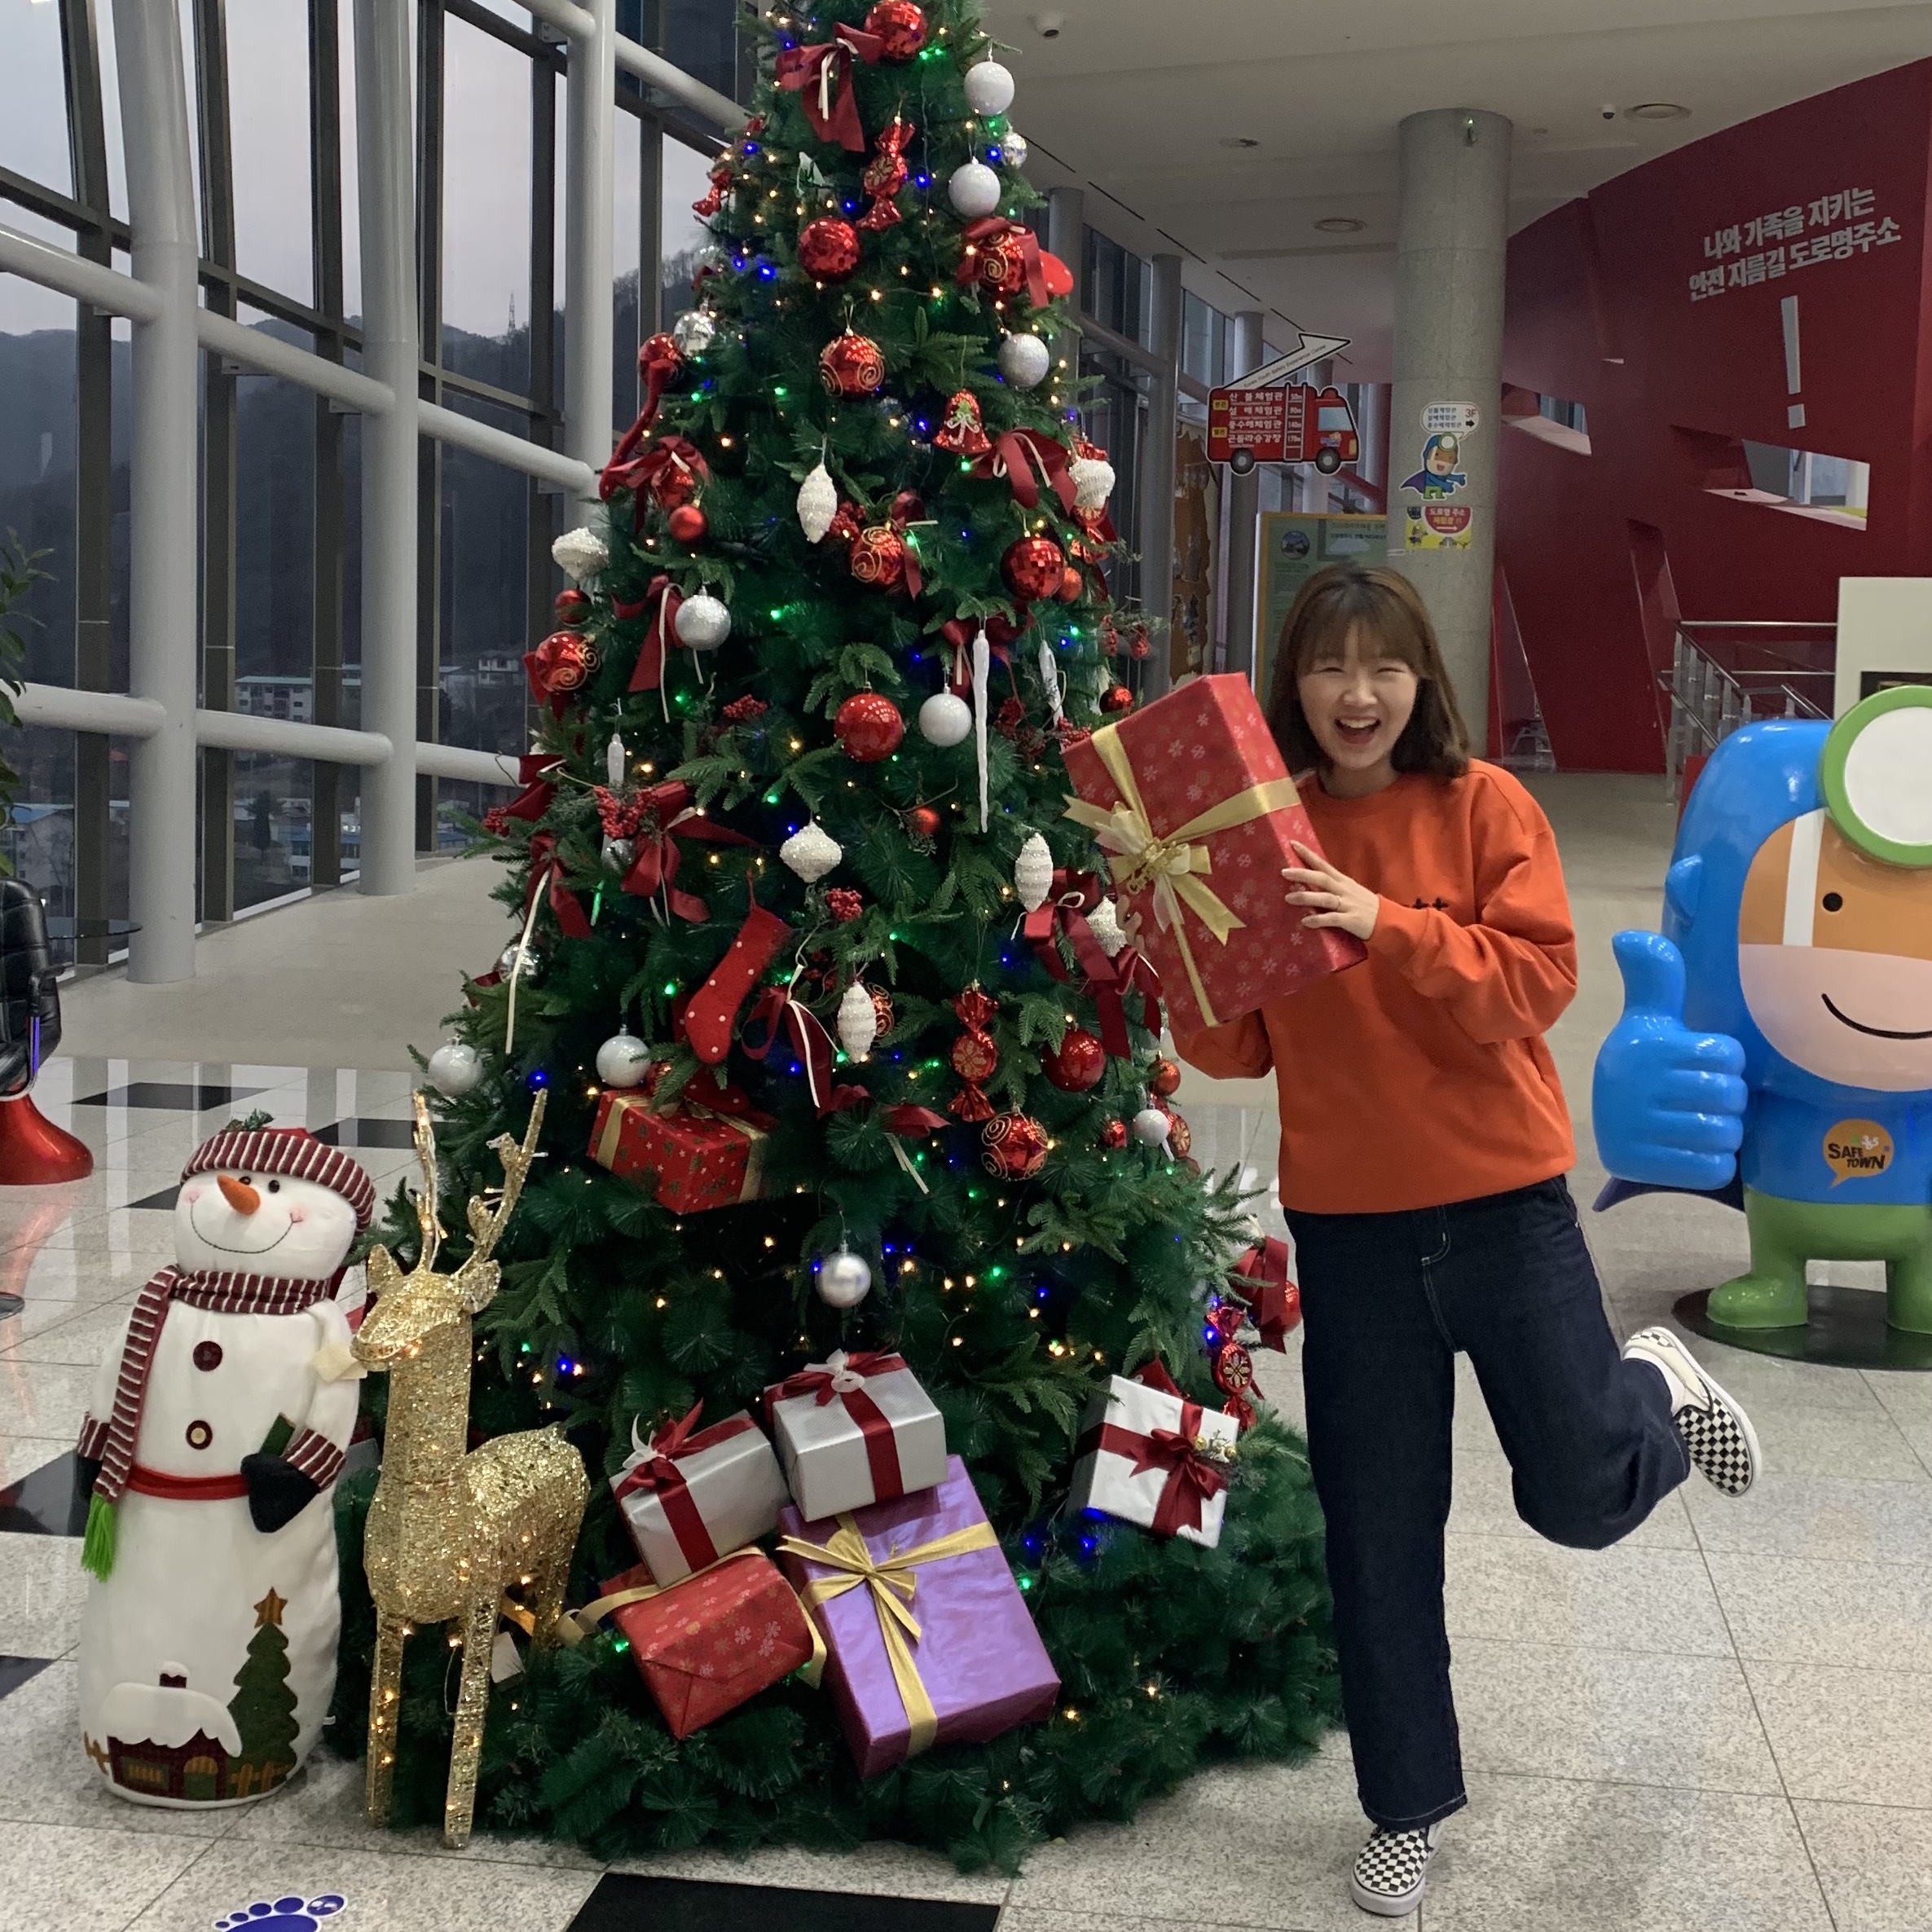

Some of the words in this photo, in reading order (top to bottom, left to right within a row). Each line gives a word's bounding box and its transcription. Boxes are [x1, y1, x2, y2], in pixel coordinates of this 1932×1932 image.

[1704, 224, 1741, 259] 나와
[1745, 206, 1804, 246] 가족을
[1808, 187, 1875, 227] 지키는
[1689, 265, 1725, 301] 안전
[1728, 246, 1786, 287] 지름길
[1789, 217, 1902, 270] 도로명주소
[1465, 408, 1477, 418] 3F
[1828, 1142, 1864, 1160] SAFE
[1846, 1154, 1886, 1169] TOWN
